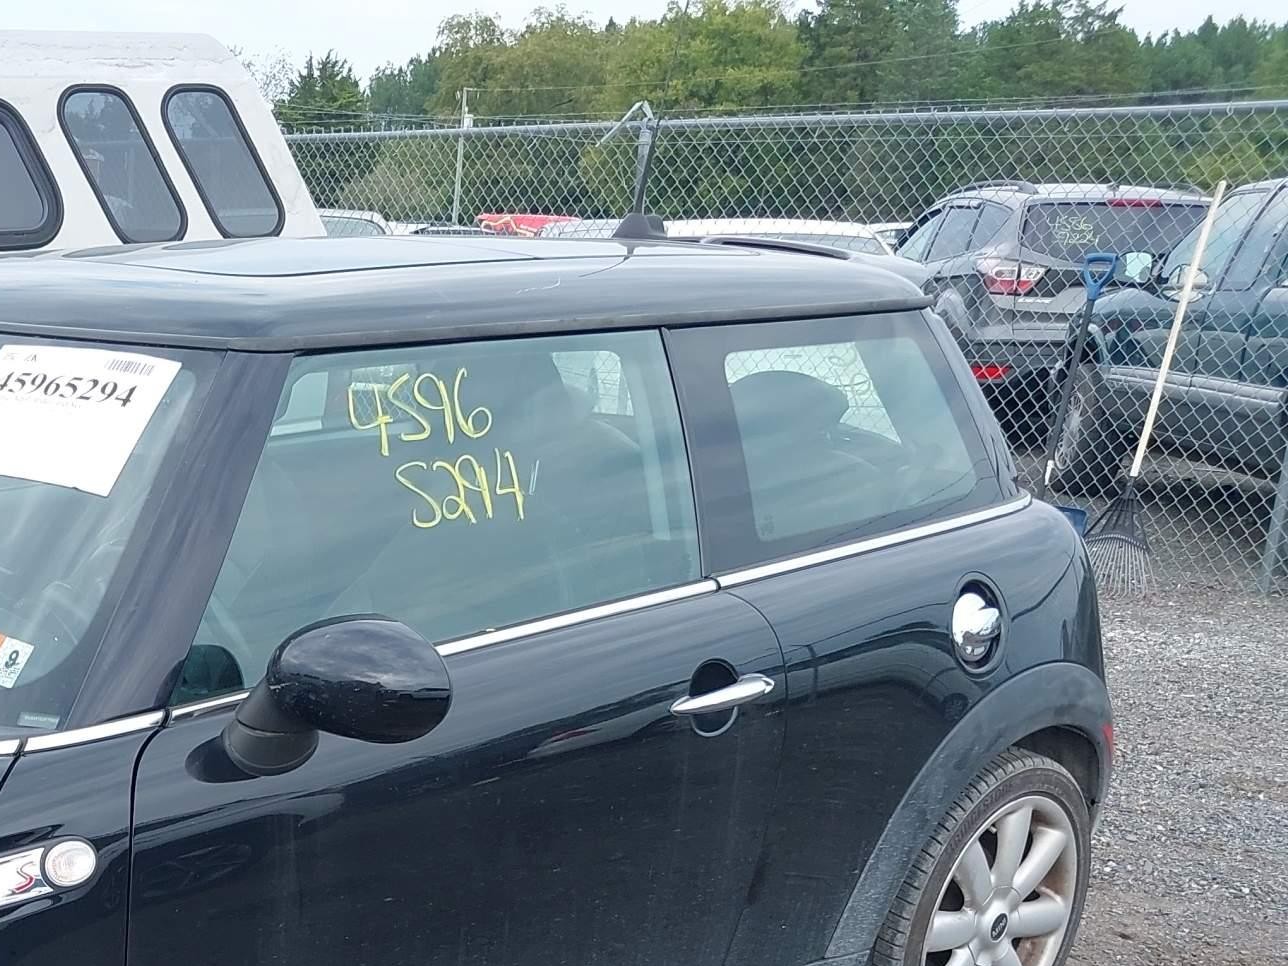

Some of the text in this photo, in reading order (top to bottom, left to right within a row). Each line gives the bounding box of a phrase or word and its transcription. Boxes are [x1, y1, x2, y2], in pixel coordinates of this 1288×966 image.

[347, 367, 493, 457] 4596
[394, 447, 525, 528] 5294
[4, 649, 20, 670] 9
